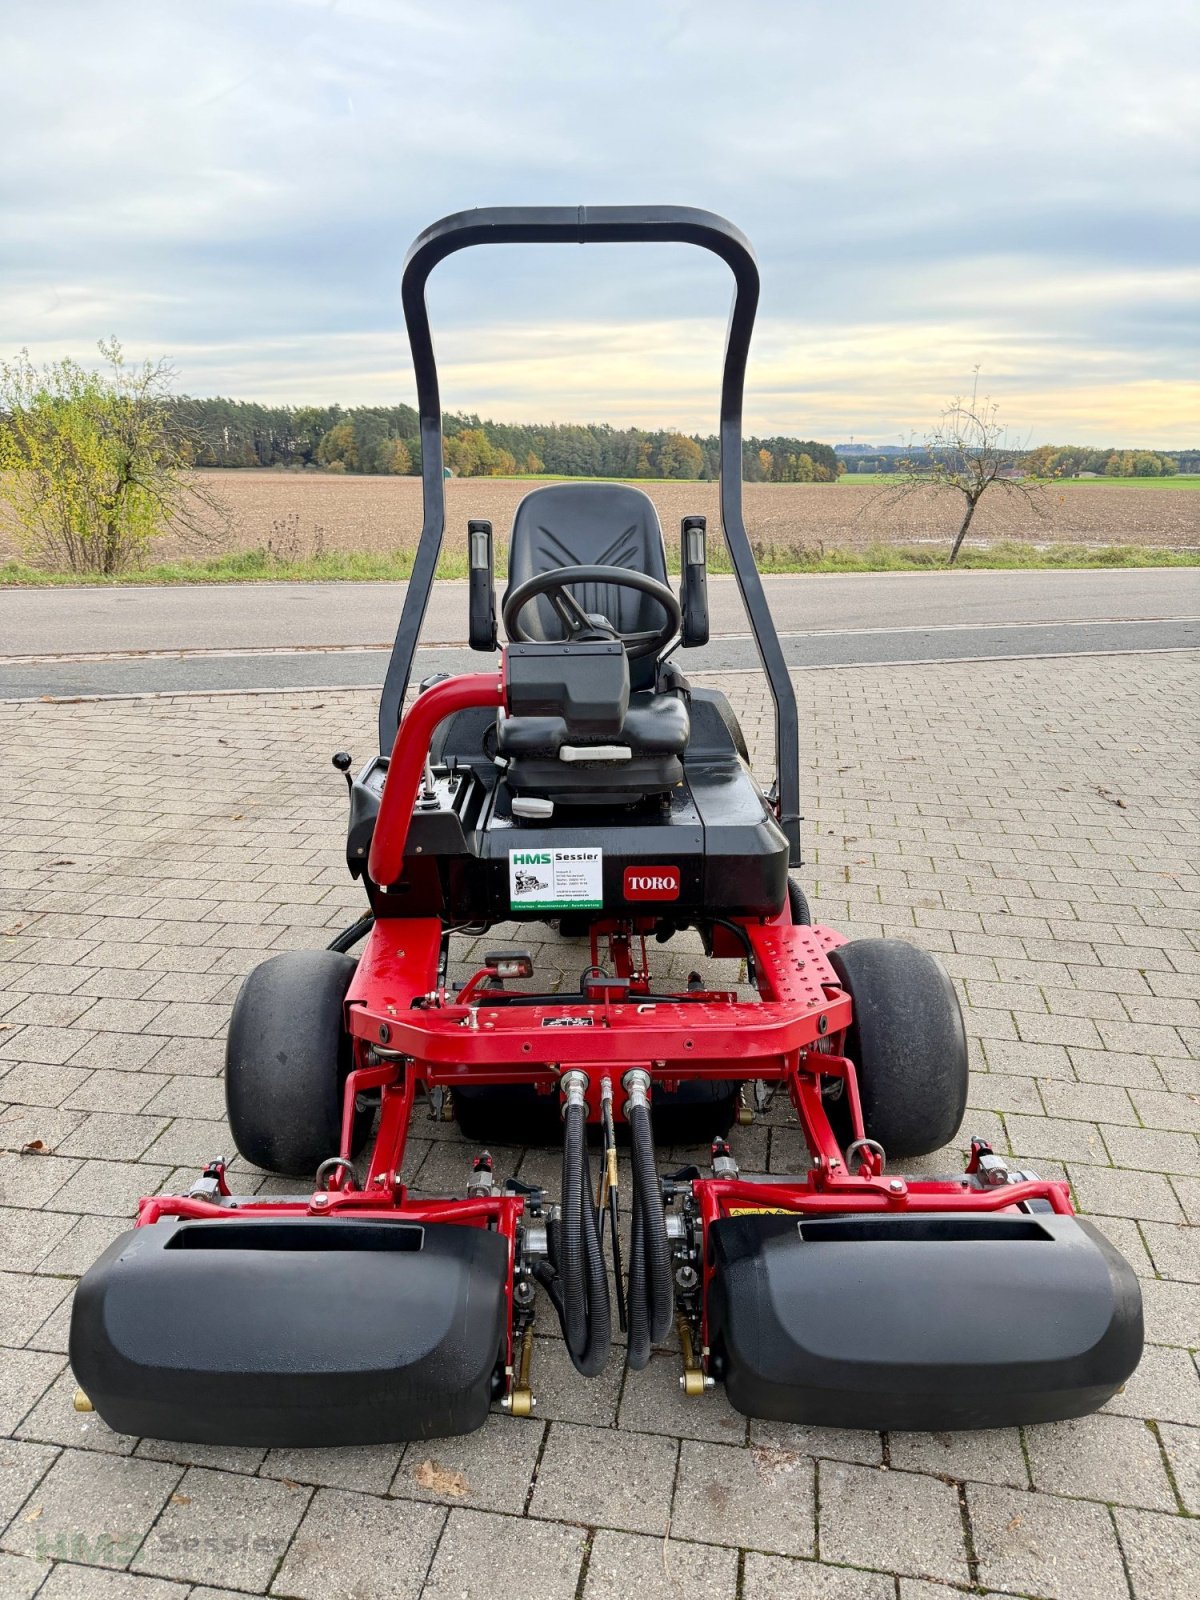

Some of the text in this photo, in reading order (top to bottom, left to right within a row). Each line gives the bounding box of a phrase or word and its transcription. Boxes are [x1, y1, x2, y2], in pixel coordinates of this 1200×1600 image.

[513, 853, 599, 865] HMS Sessler
[628, 876, 676, 890] TORO
